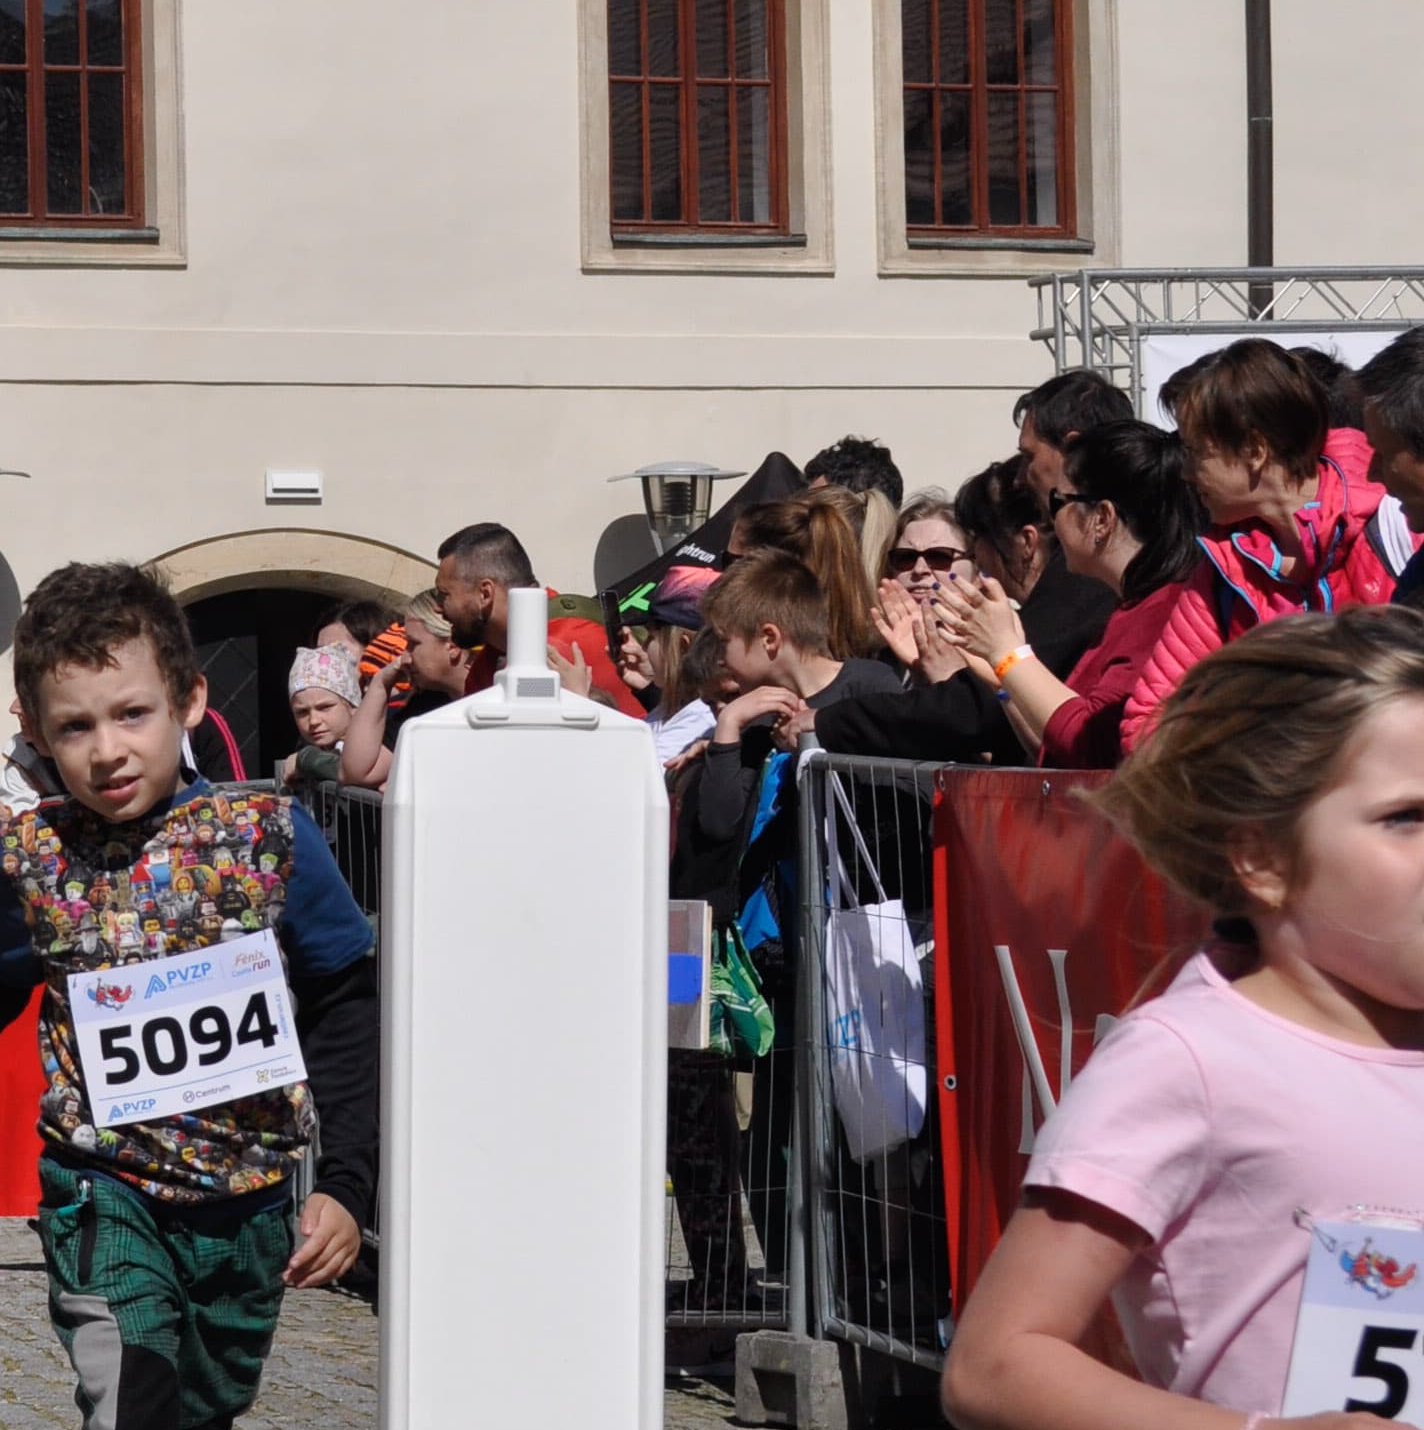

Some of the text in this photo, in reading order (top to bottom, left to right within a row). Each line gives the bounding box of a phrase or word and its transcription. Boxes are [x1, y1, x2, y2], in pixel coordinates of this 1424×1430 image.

[167, 962, 212, 985] PVZP
[99, 991, 279, 1085] 5094
[123, 1098, 156, 1114] PVZP
